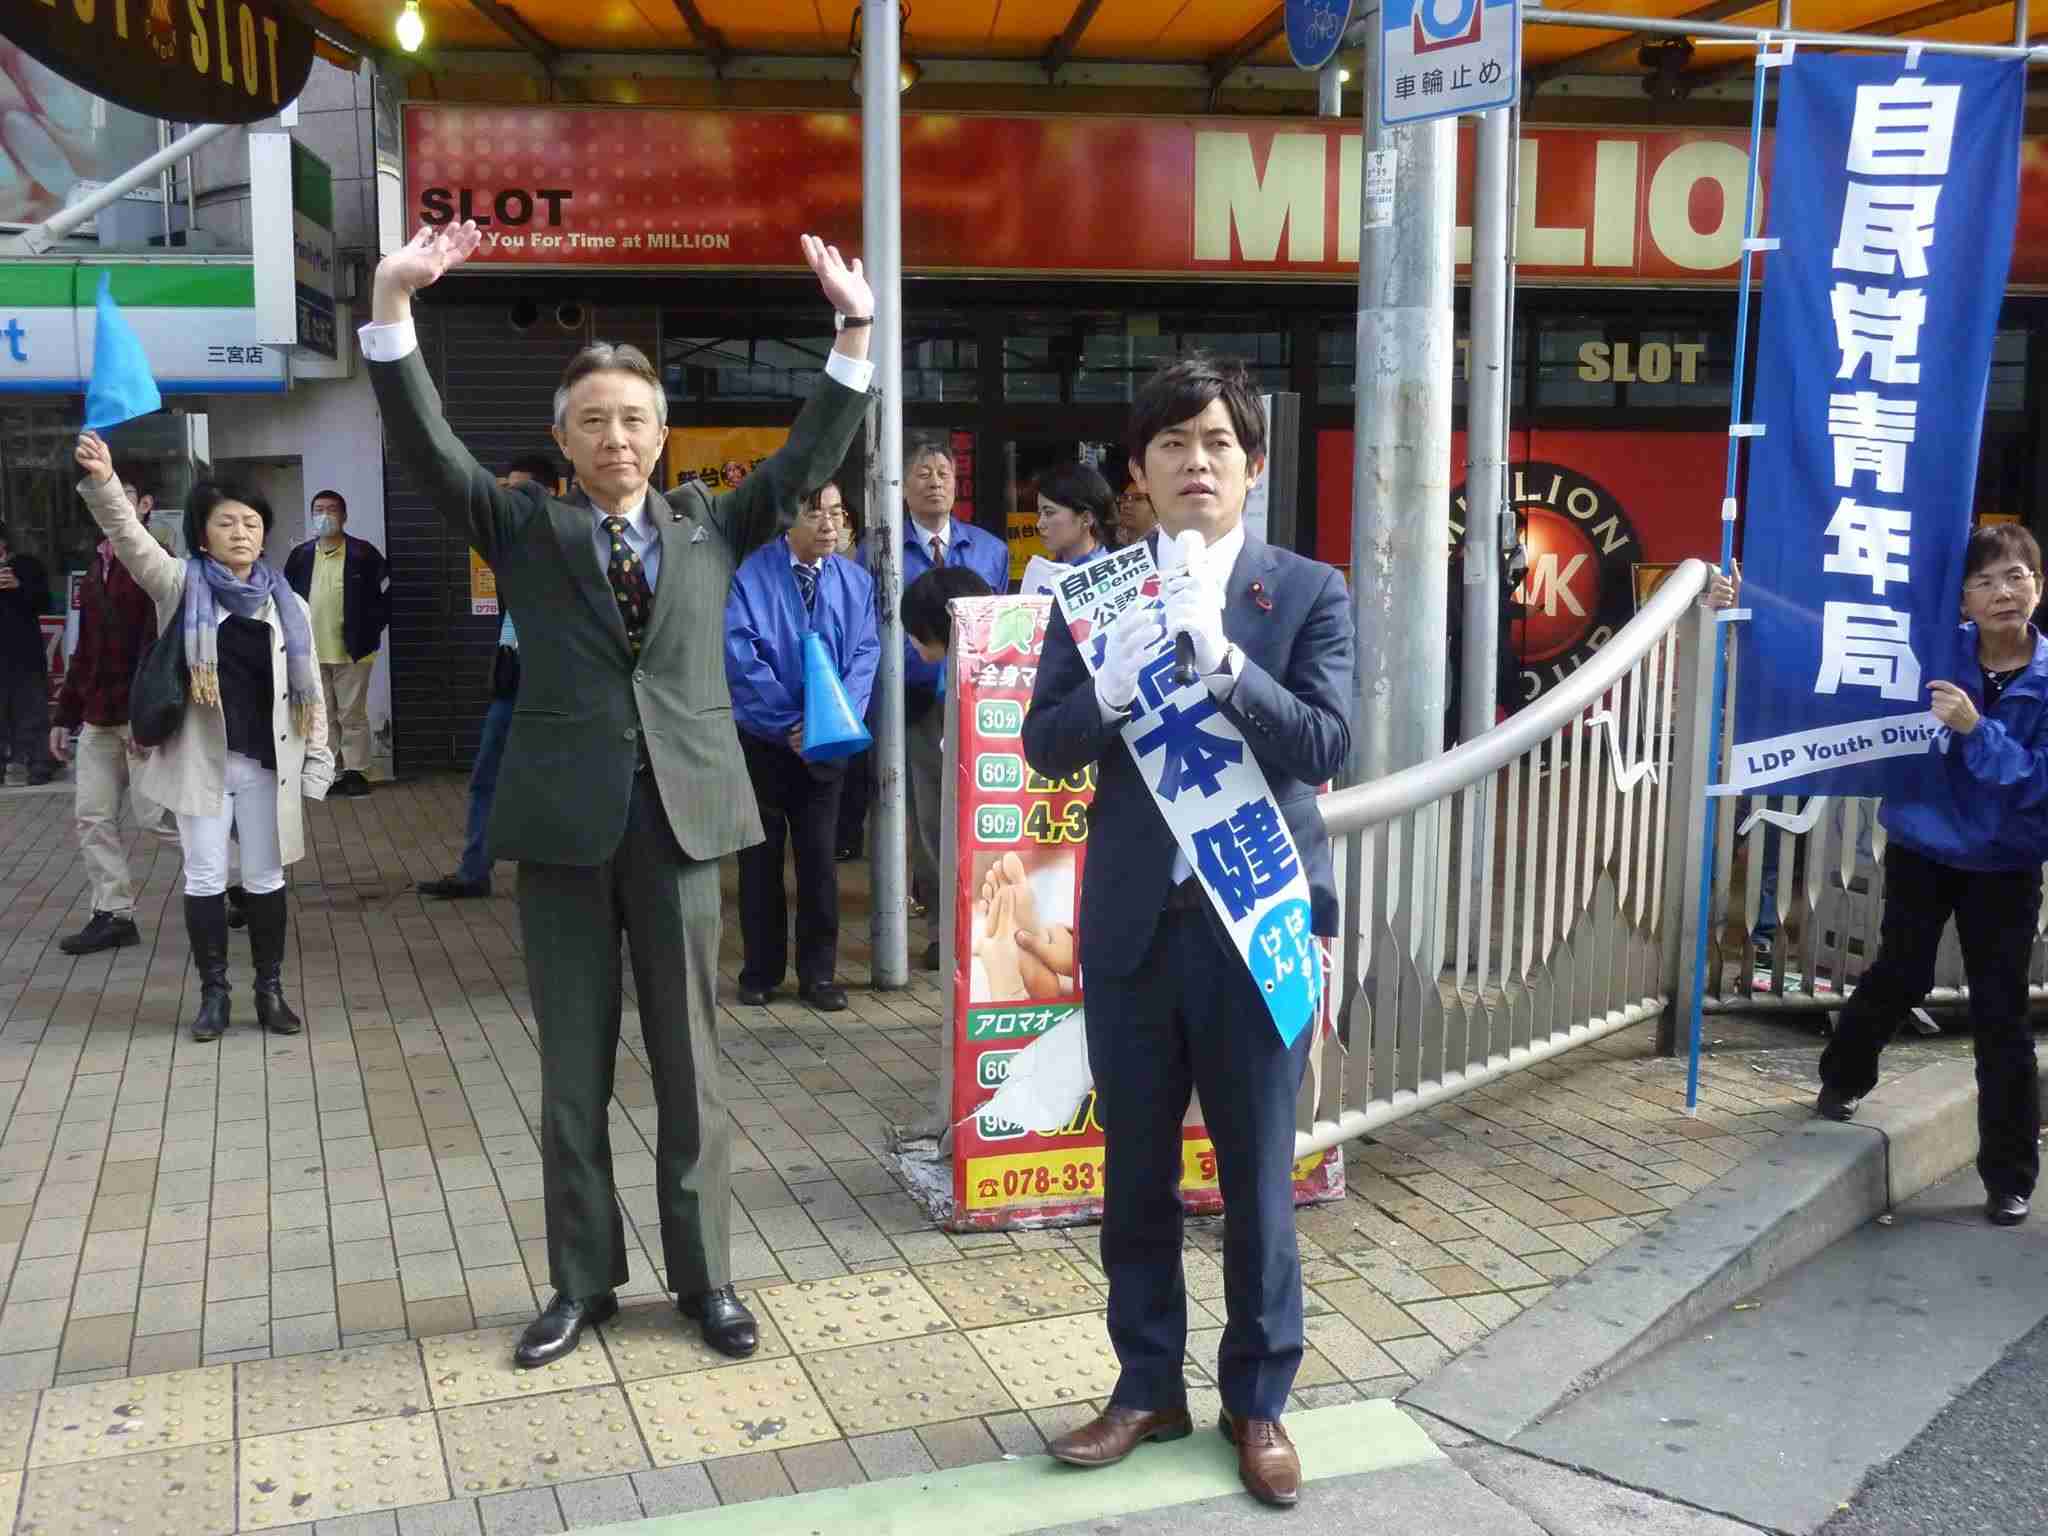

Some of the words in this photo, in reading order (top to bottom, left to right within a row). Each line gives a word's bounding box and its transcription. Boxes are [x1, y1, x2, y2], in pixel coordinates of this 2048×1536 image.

[187, 0, 279, 104] SLOT
[1394, 58, 1501, 100] 車輪止め
[419, 187, 573, 227] SLOT
[487, 232, 525, 248] You
[531, 232, 563, 248] For
[567, 232, 616, 248] Time
[622, 234, 641, 248] at
[647, 234, 730, 249] MILLION
[207, 346, 264, 364] 三宮店
[1578, 341, 1705, 383] SLOT
[1814, 77, 1962, 701] 自民党青年局
[1060, 548, 1147, 601] 自民党
[1066, 590, 1096, 612] Lib
[1099, 562, 1150, 593] Dems
[983, 709, 1018, 730] 30分
[982, 764, 1018, 784] 60分
[1747, 749, 1796, 775] LDP
[1802, 734, 1874, 762] Youth
[981, 814, 1017, 834] 90分
[1259, 925, 1294, 983] けん
